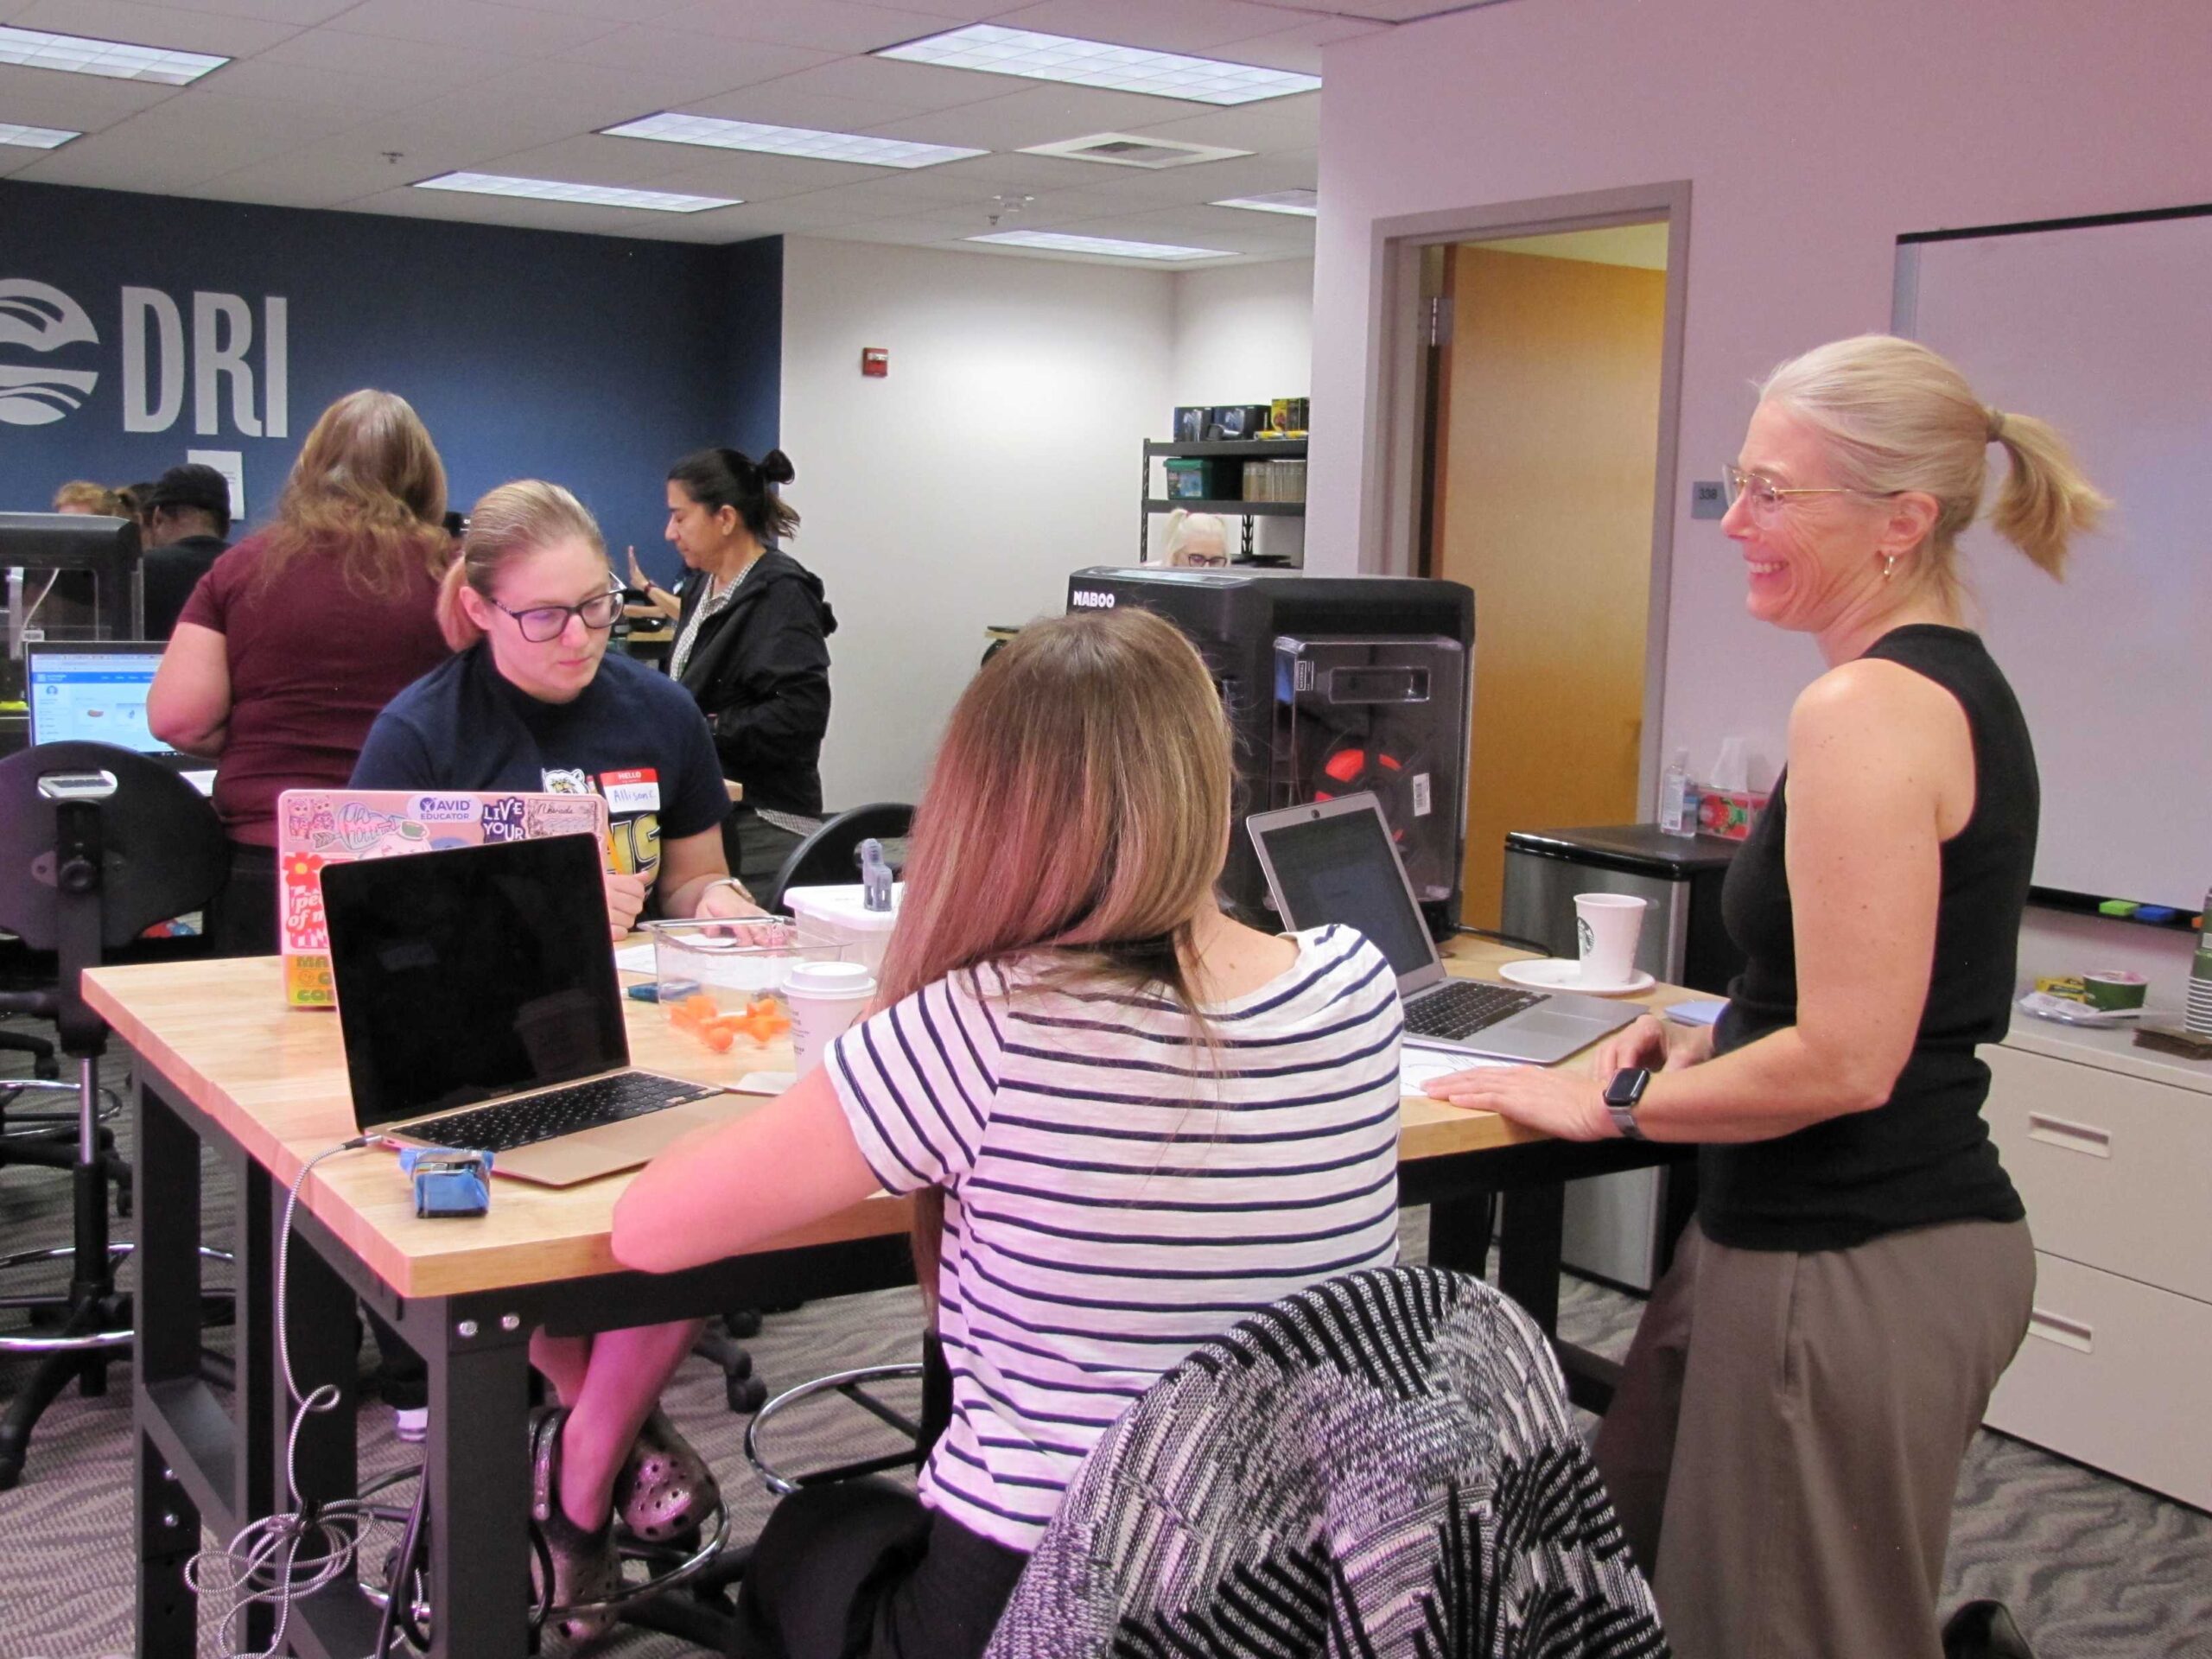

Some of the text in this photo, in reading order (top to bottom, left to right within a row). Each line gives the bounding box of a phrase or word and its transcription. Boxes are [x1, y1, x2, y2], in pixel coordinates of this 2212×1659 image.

[122, 286, 288, 438] DRI
[1073, 590, 1115, 607] NABOO
[618, 771, 641, 779] HELLO
[613, 788, 648, 803] Allison
[437, 800, 470, 810] AVID
[484, 798, 523, 821] LIVE
[483, 822, 524, 842] YOUR
